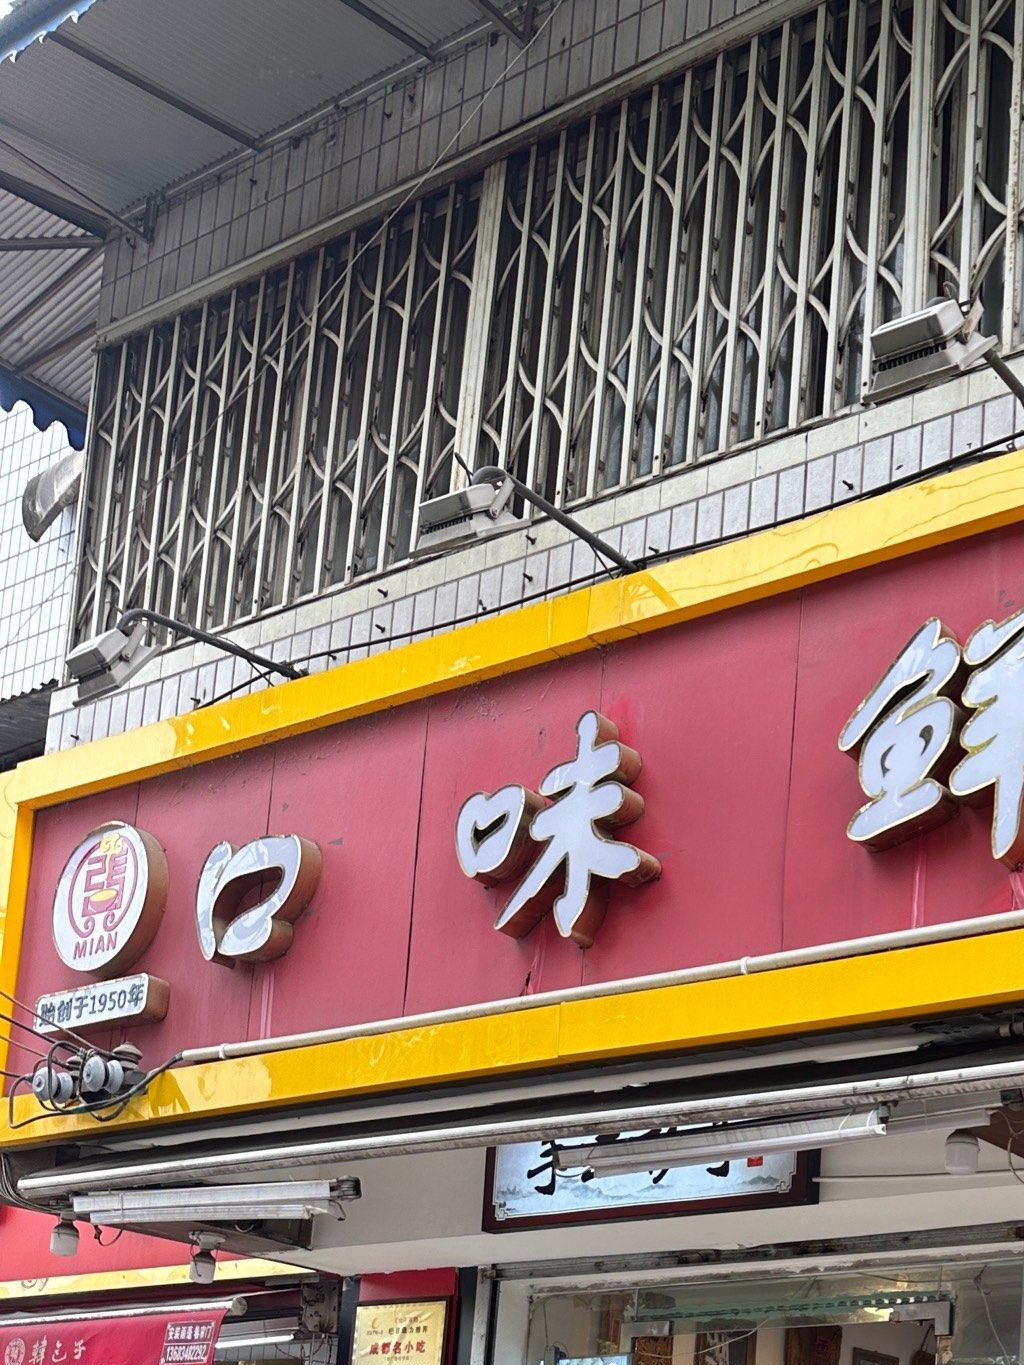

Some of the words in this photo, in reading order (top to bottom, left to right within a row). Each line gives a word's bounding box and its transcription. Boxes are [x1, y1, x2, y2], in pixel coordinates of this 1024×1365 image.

[73, 931, 118, 960] MIAN
[369, 1340, 426, 1355] 成都名小吃
